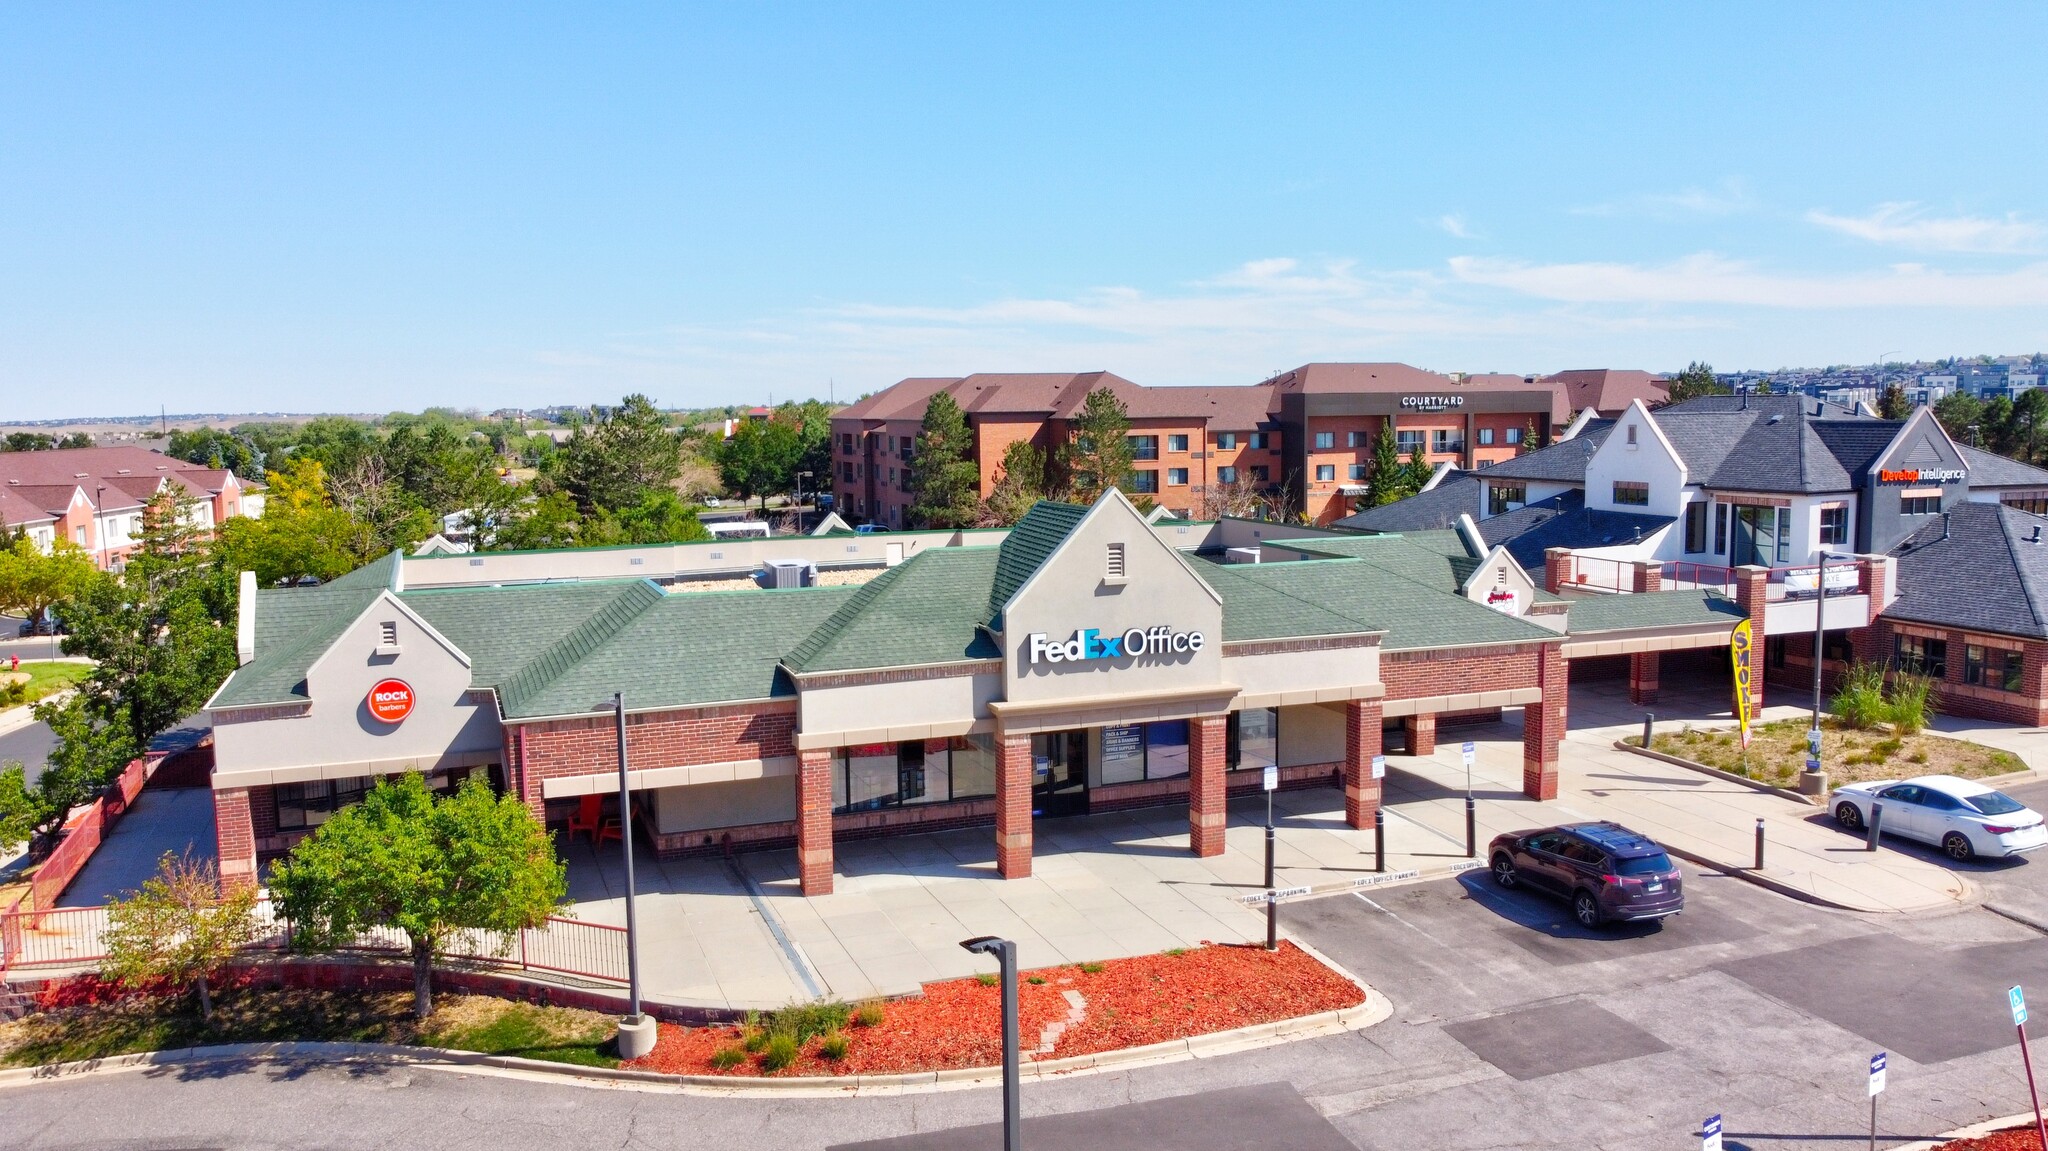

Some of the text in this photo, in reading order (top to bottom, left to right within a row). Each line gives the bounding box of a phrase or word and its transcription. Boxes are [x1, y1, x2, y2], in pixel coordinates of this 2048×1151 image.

[1402, 396, 1464, 406] COURTYARD
[1030, 626, 1205, 664] FedEx Office
[375, 690, 409, 702] ROCK
[379, 704, 406, 712] barbers
